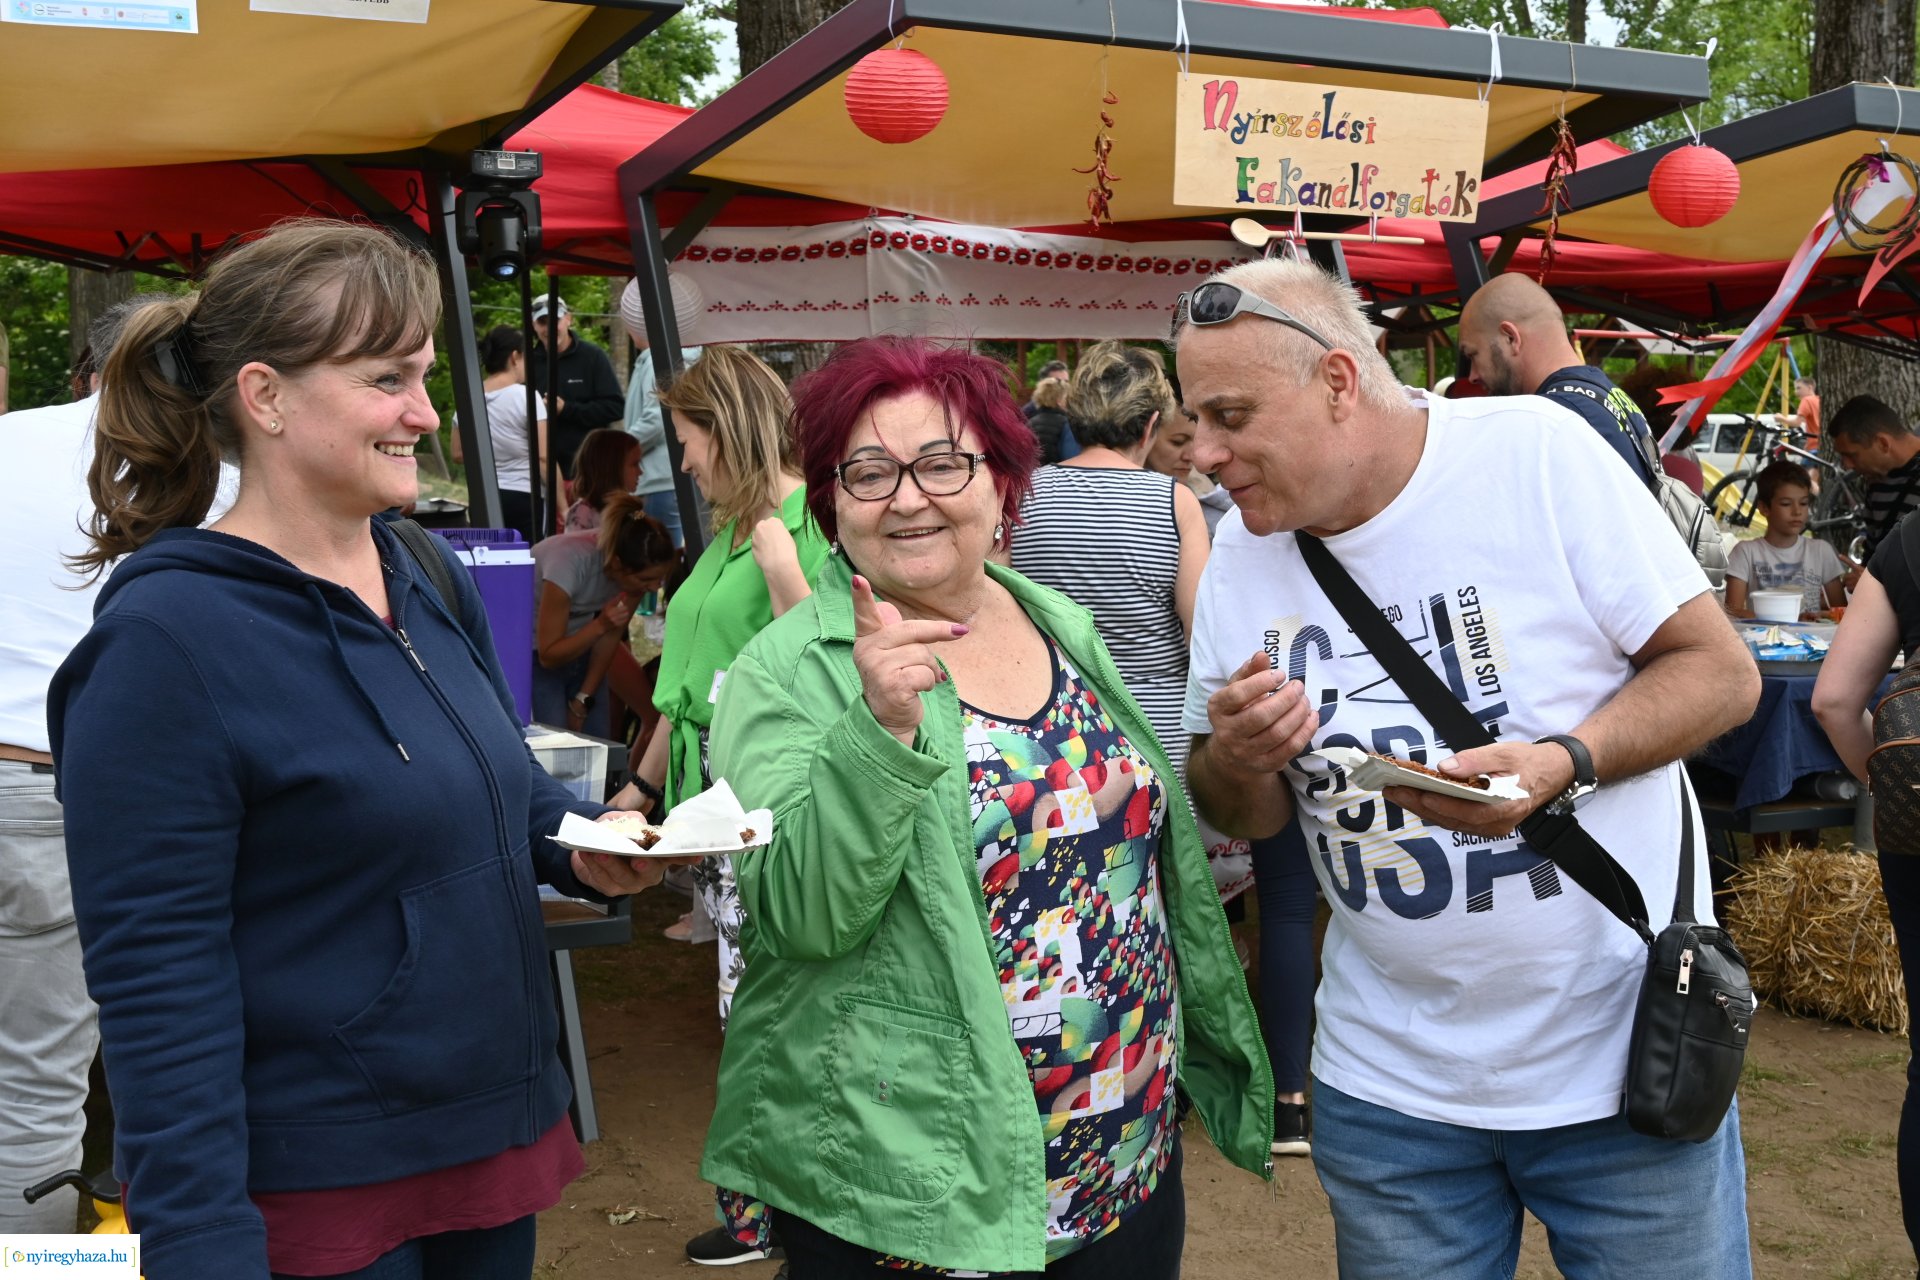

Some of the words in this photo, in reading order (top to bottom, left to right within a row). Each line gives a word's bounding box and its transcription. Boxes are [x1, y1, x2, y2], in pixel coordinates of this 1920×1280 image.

[1235, 156, 1477, 218] Fakanálforgatók
[1563, 385, 1597, 399] BAG
[1457, 585, 1493, 660] ANGELES
[1475, 663, 1502, 697] LOS
